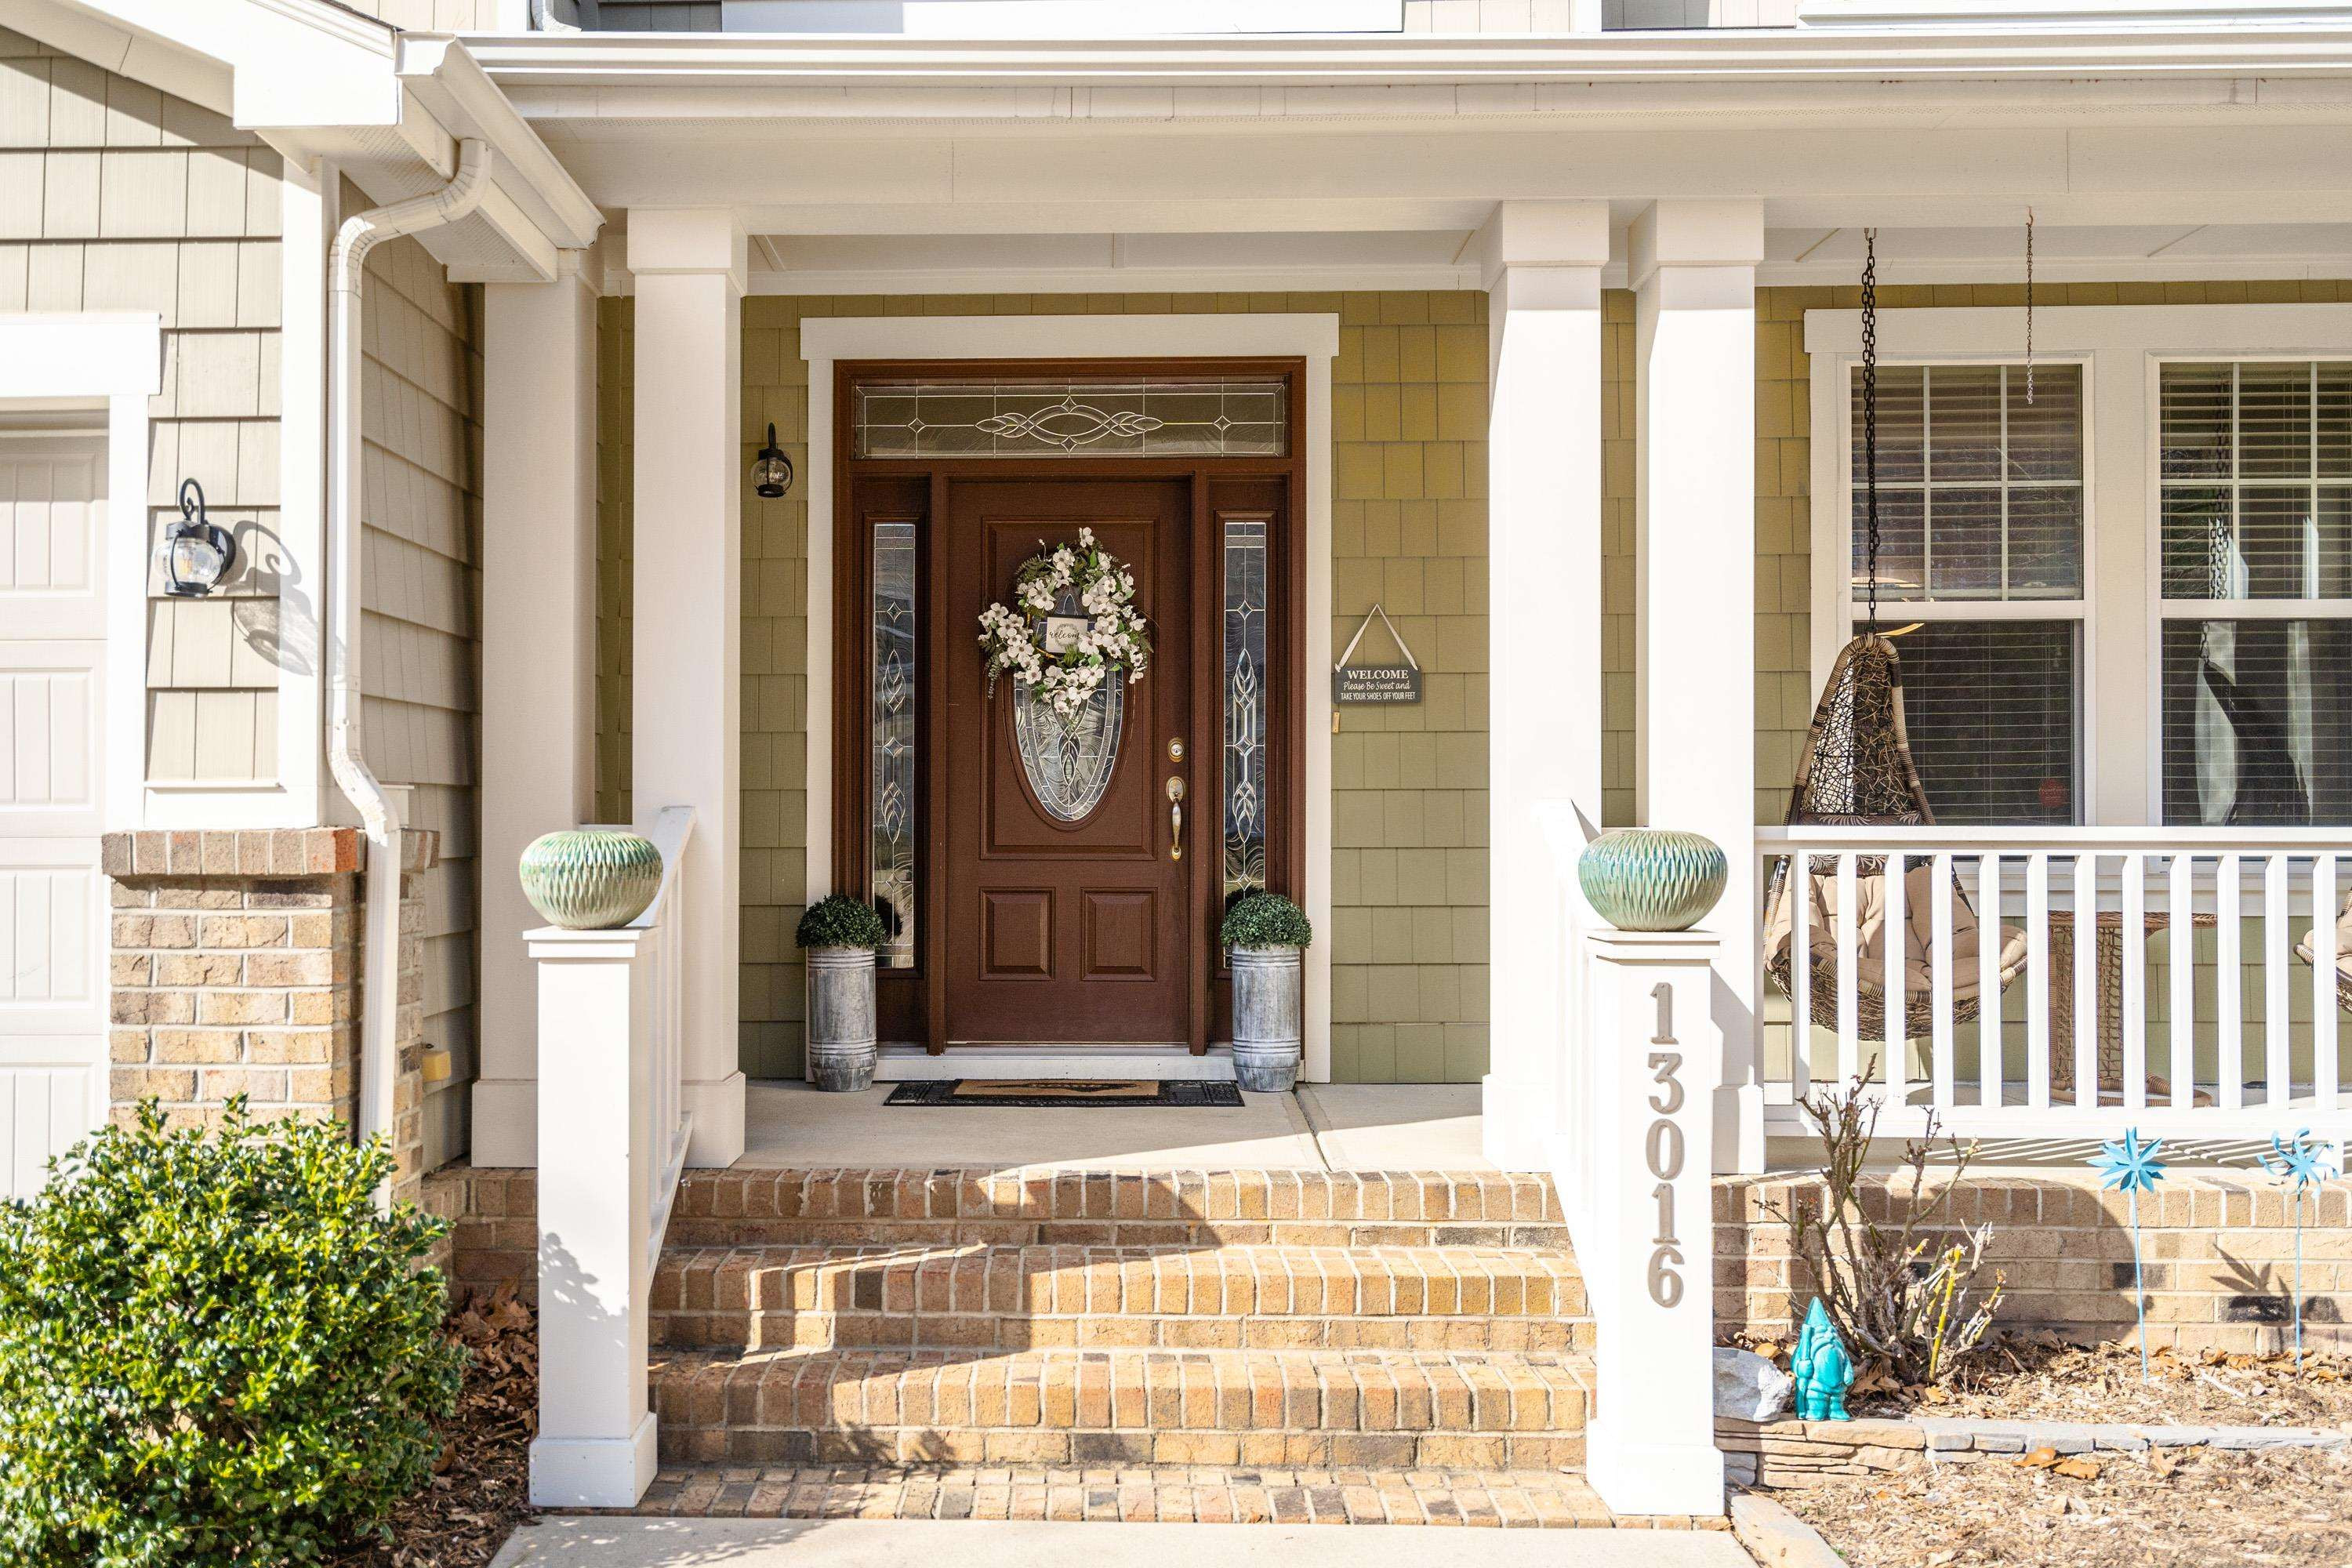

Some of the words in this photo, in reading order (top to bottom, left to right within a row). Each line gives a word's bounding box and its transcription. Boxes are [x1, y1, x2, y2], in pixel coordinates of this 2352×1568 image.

[1049, 630, 1080, 639] welcom
[1347, 670, 1409, 679] WELCOME
[1343, 681, 1366, 691] Please
[1396, 681, 1411, 689] and
[1645, 982, 1685, 1309] 13016
